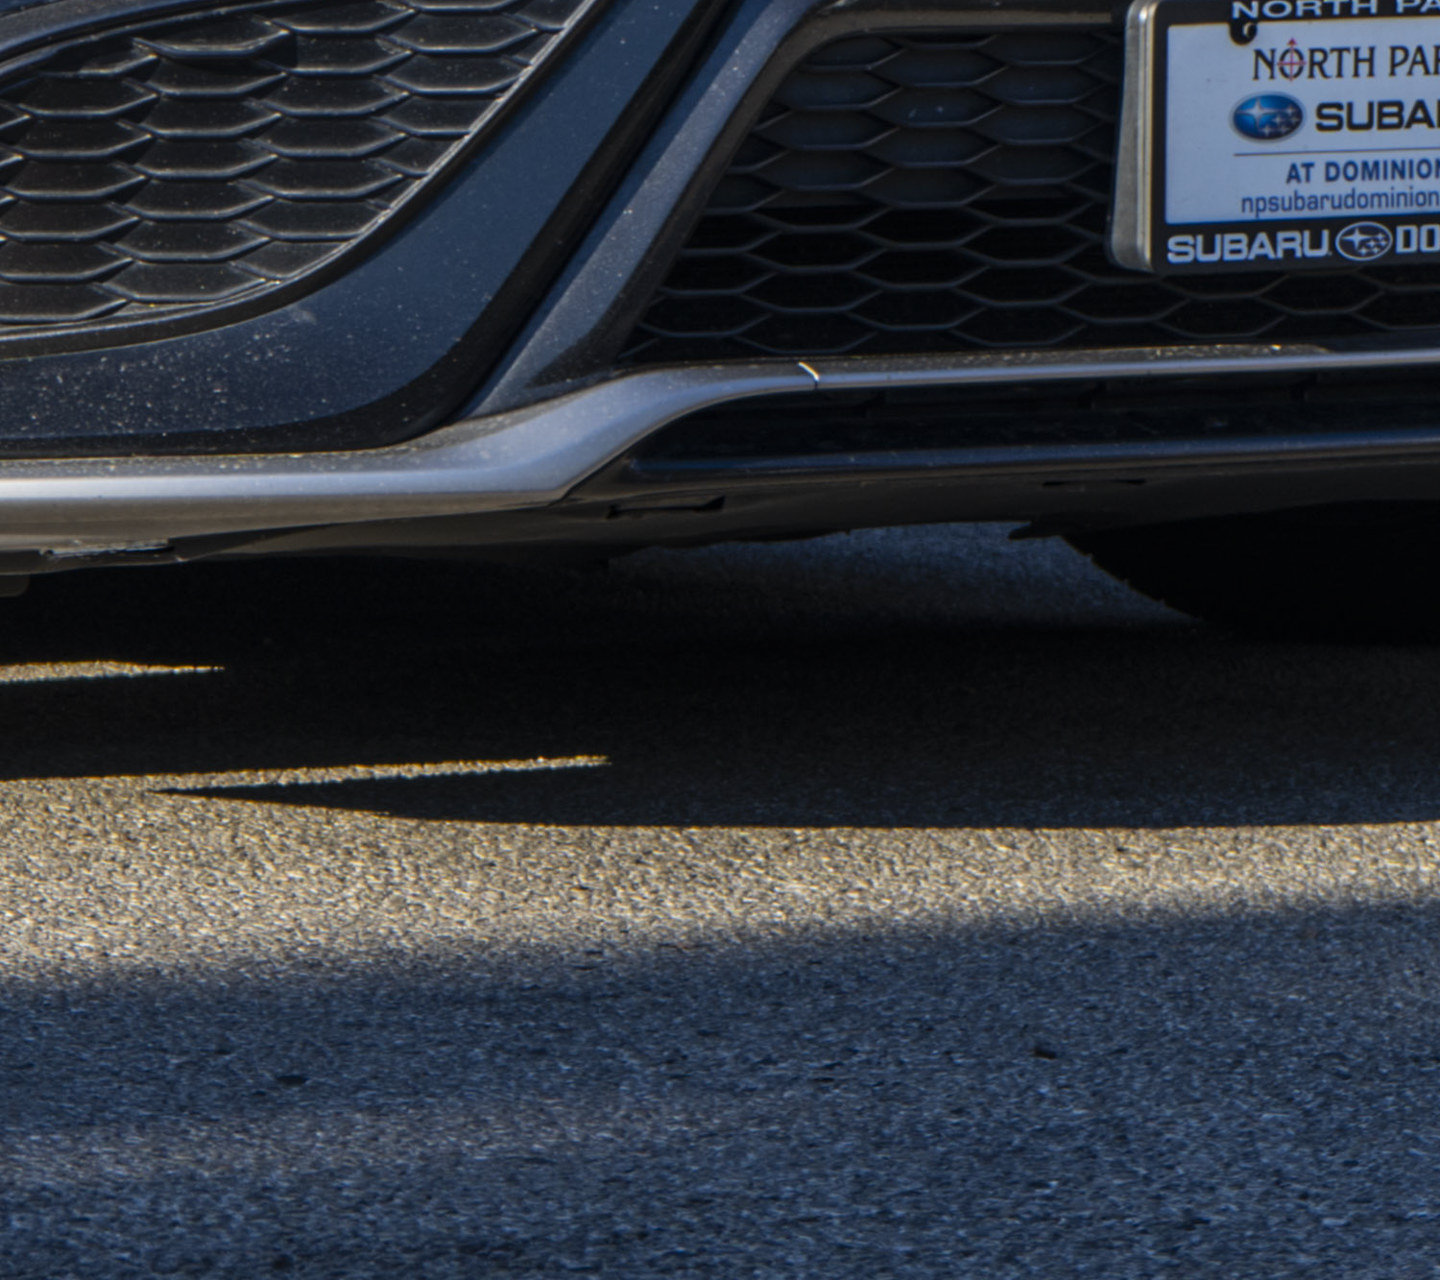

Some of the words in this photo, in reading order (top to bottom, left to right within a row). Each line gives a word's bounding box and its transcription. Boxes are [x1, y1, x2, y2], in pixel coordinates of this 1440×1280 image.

[1252, 44, 1376, 81] NORTH
[1285, 162, 1317, 184] AT
[1166, 228, 1331, 265] SUBARU
